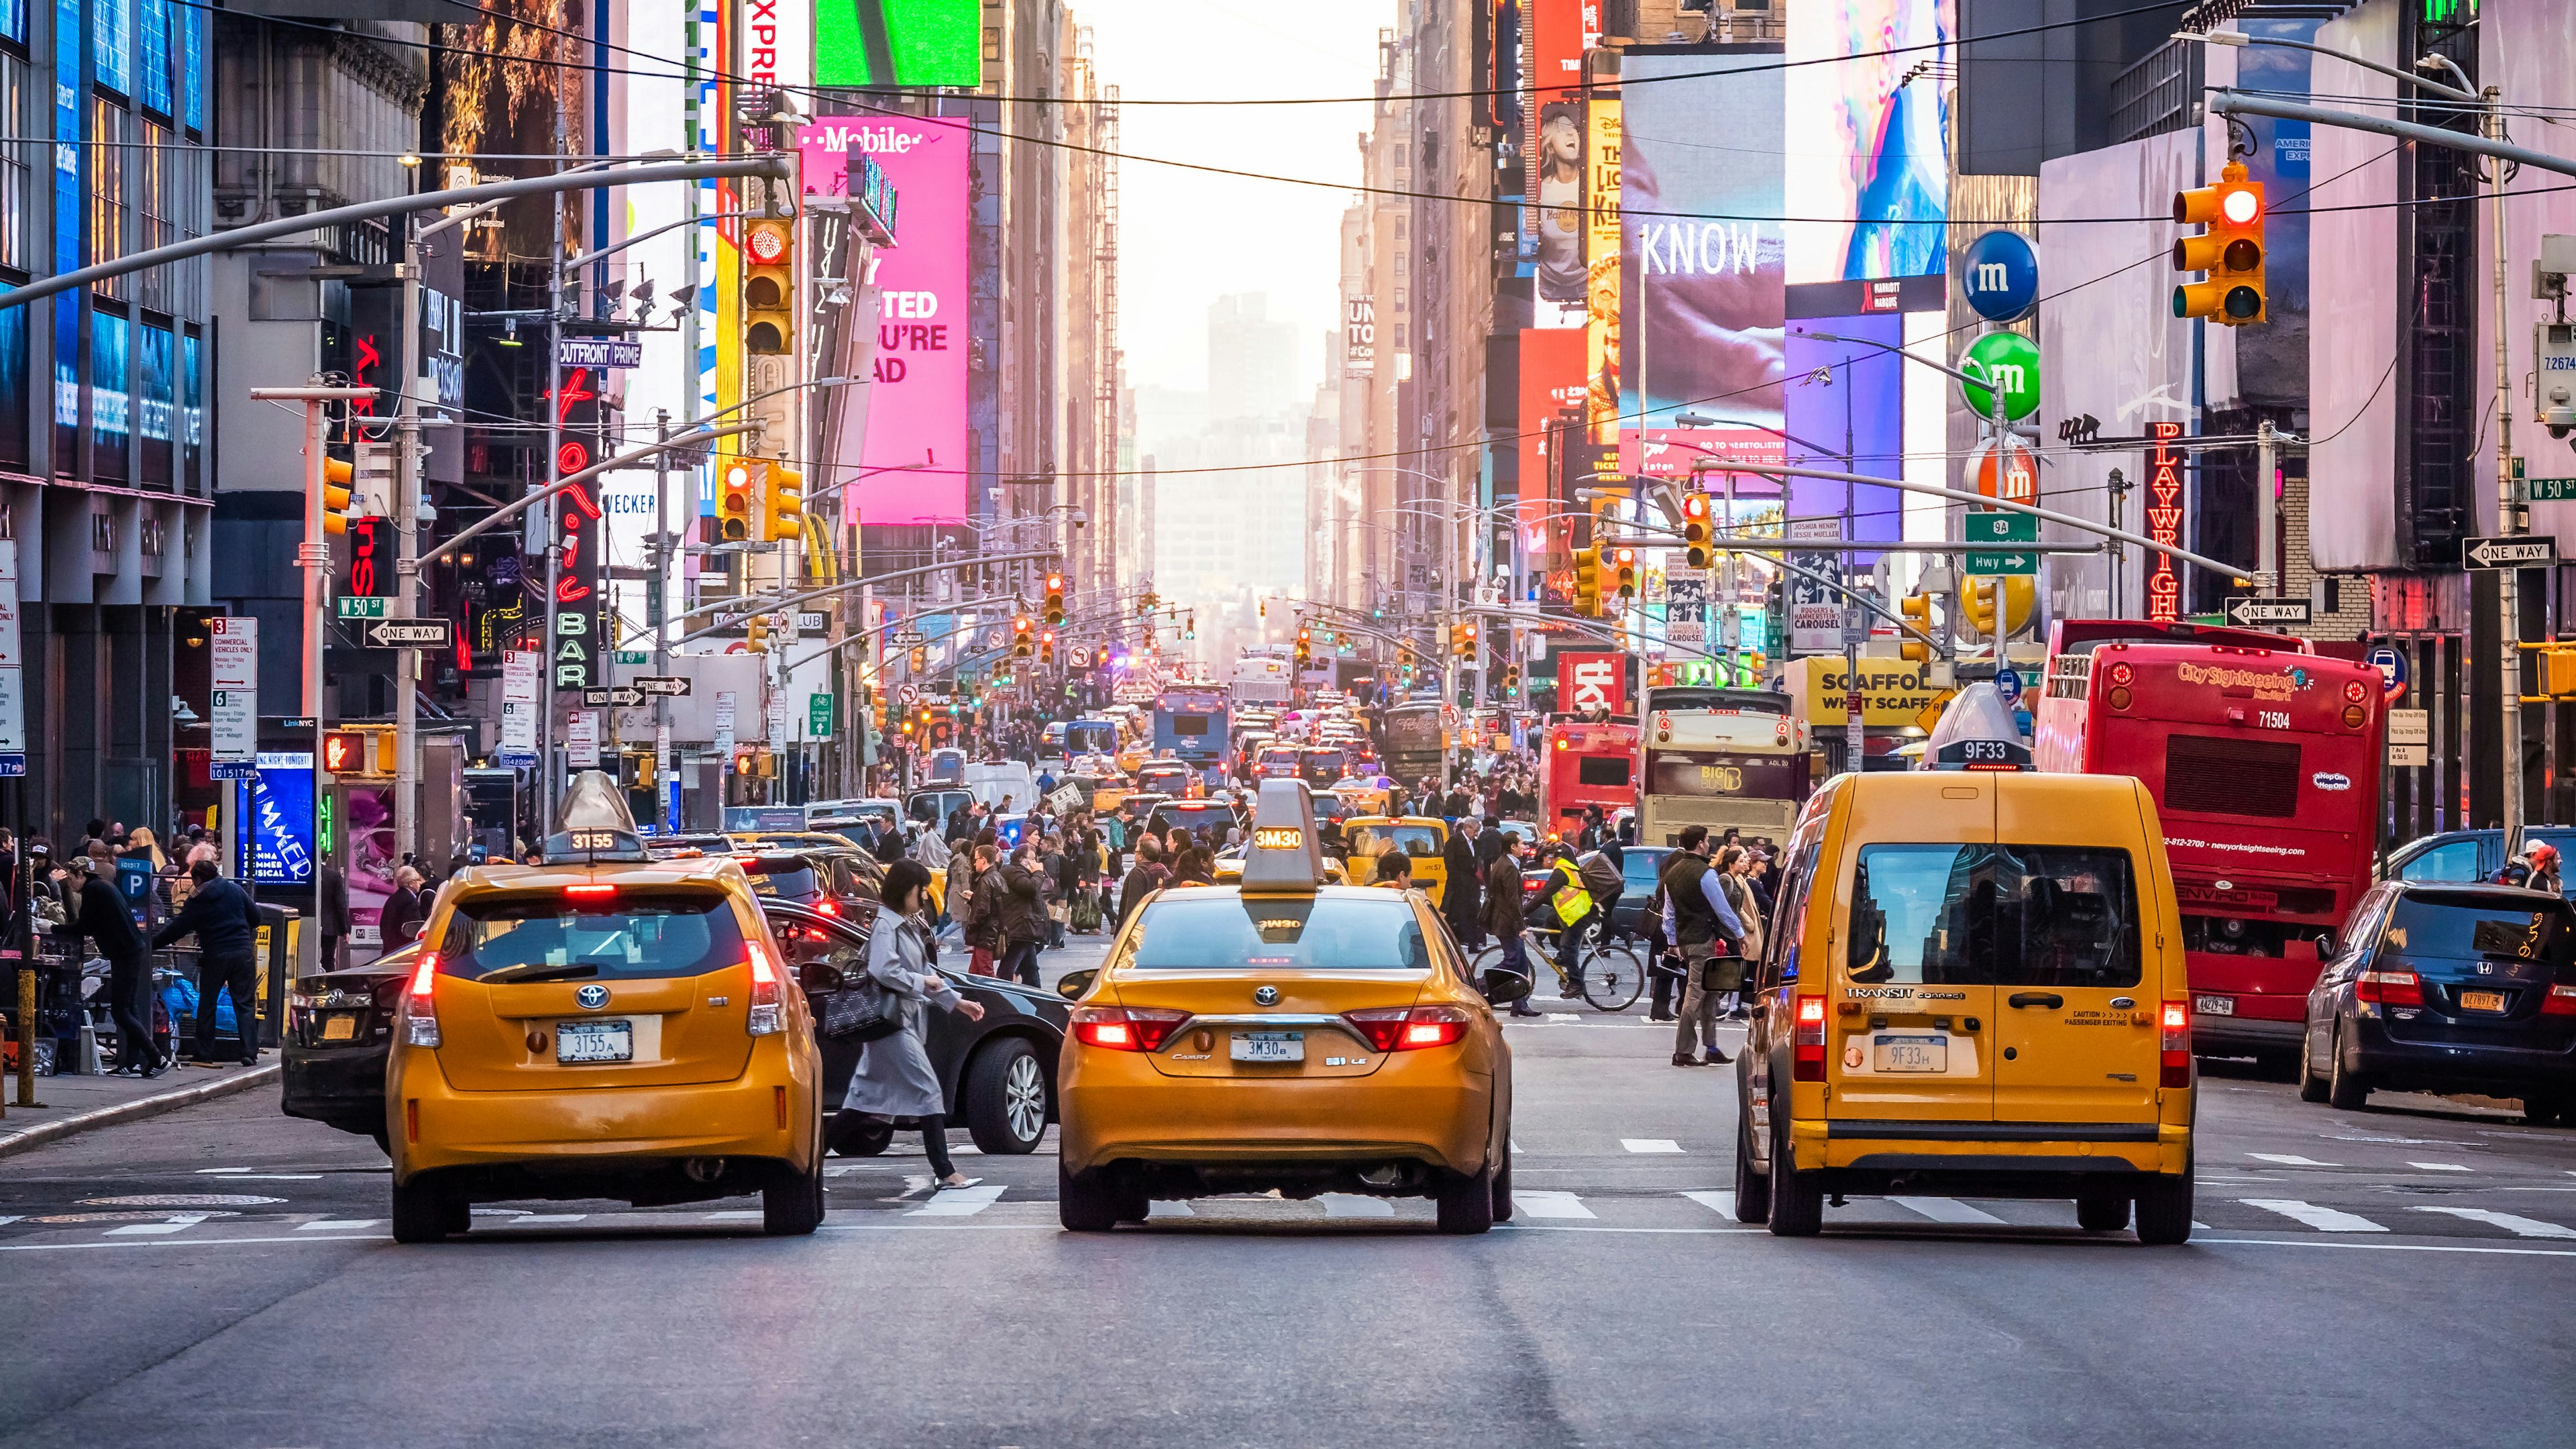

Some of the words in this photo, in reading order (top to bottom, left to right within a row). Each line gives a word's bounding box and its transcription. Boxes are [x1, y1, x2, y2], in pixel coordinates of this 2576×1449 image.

[1642, 223, 1758, 275] KNOW
[1979, 262, 2008, 291] m
[1874, 282, 1900, 294] MARRIOTT
[1874, 296, 1898, 309] MARQUIS
[877, 325, 948, 350] U'RE
[560, 343, 610, 364] OUTFRONT
[614, 345, 639, 365] PRIME
[2544, 357, 2576, 370] 72674
[1990, 364, 2025, 393] m
[1700, 441, 1713, 449] GO
[1715, 441, 1726, 449] TO
[2006, 469, 2031, 499] m
[2534, 482, 2544, 498] W
[2546, 480, 2561, 498] 50
[2566, 480, 2576, 493] ST
[1994, 523, 2007, 533] 9A
[2481, 546, 2509, 559] ONE
[2515, 545, 2542, 559] WAY
[1976, 557, 1999, 570] Hwy
[340, 600, 350, 615] W
[354, 598, 368, 616] 50
[372, 599, 381, 608] ST
[2242, 605, 2268, 619] ONE
[2274, 604, 2301, 619] WAY
[215, 619, 224, 635] 3
[798, 616, 822, 627] LUB
[1794, 619, 1840, 629] CAROUSEL
[380, 628, 406, 639] ONE
[413, 627, 439, 639] WAY
[1668, 634, 1704, 643] CAROUSEL
[556, 612, 587, 687] BAR
[627, 651, 636, 663] 49
[2021, 674, 2031, 686] W
[2178, 662, 2210, 684] City
[2208, 666, 2296, 692] Sightseeing
[665, 682, 683, 692] WAY
[215, 692, 224, 706] 6
[618, 692, 637, 702] WAY
[1821, 697, 1868, 709] WHT
[283, 718, 313, 728] LinkNYC
[2259, 710, 2290, 729] 71504
[1965, 743, 2006, 759] 9F33
[212, 769, 245, 779] 101517
[1701, 766, 1723, 780] BIG
[1701, 780, 1723, 790] BUS
[572, 833, 614, 849] 3T55
[1254, 830, 1302, 847] 3M30
[2211, 841, 2306, 856] newyorksightseeing.com
[130, 875, 143, 894] P
[2175, 885, 2248, 902] ENVIRO
[1845, 988, 1915, 998] TRANSIT
[2463, 994, 2491, 1007] 627897
[2103, 1019, 2128, 1027] EXITING
